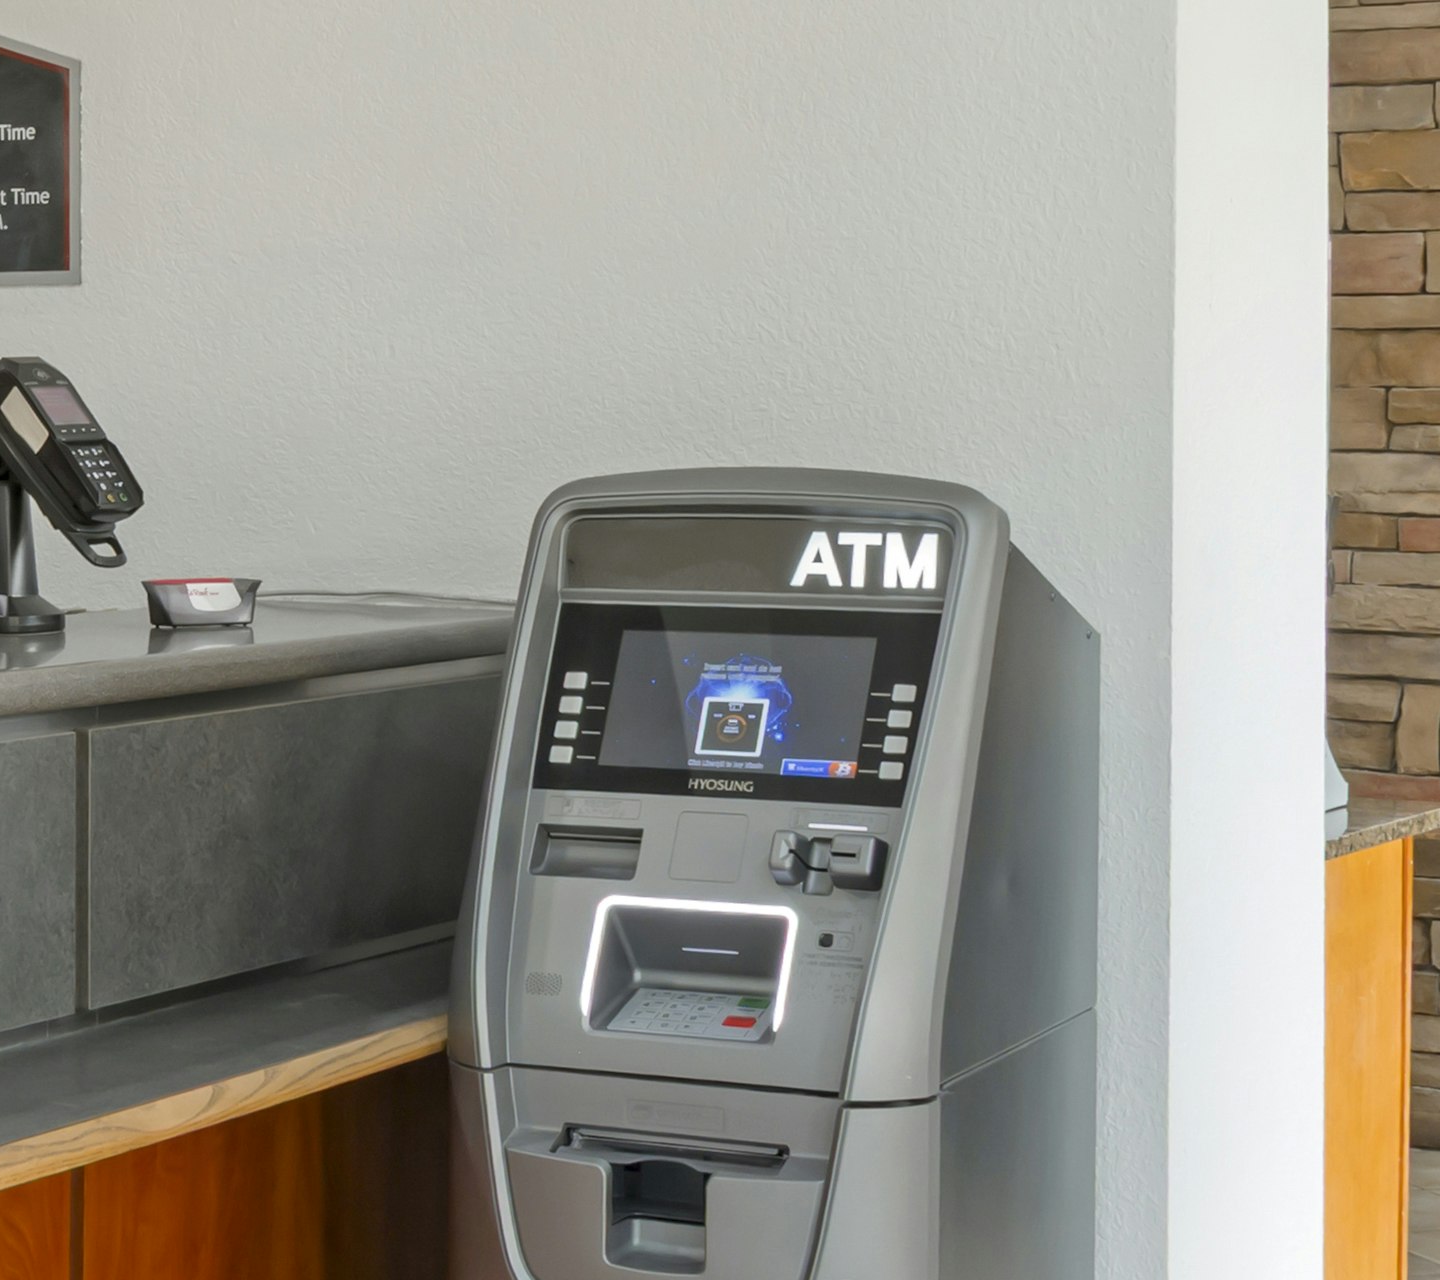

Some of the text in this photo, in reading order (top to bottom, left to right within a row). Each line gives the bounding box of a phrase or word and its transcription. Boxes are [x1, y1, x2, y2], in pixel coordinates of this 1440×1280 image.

[10, 188, 50, 205] Time
[790, 531, 939, 589] ATM
[688, 779, 754, 792] HYOSUNG
